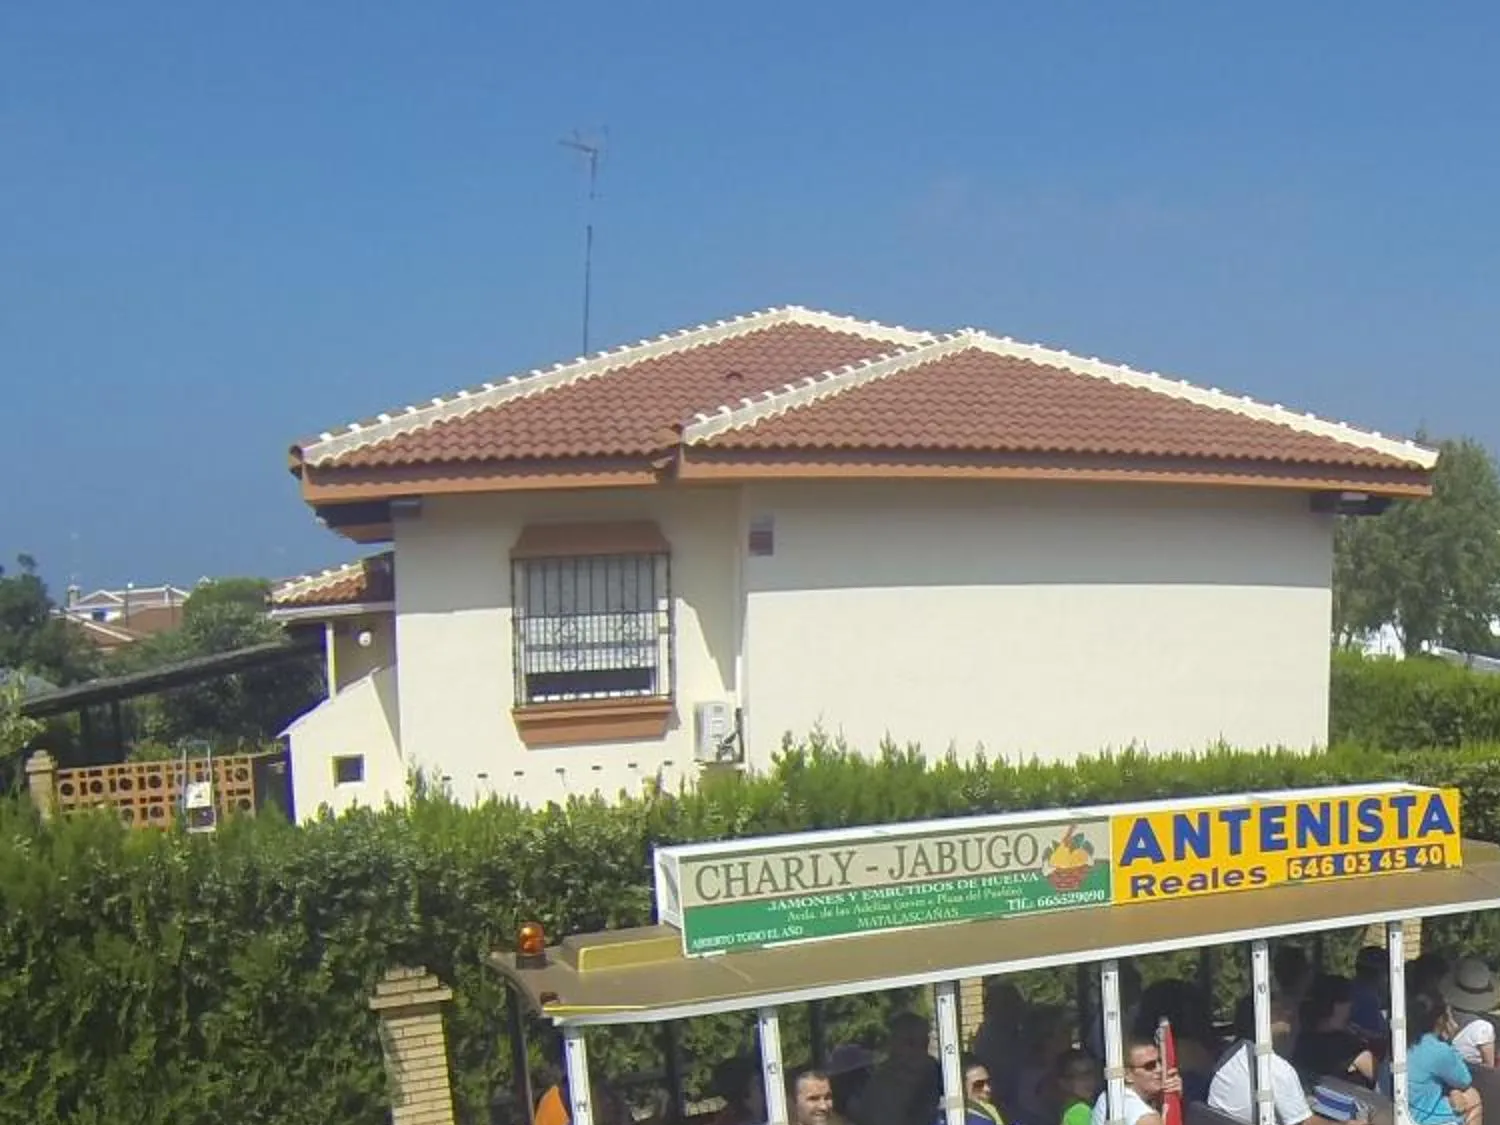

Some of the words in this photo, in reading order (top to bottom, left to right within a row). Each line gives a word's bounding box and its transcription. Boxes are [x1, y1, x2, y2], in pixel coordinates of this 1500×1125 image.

[1119, 793, 1454, 867] ANTENISTA
[695, 850, 857, 901] CHARLY
[888, 833, 1039, 881] JABUGO
[1130, 865, 1268, 898] Reales
[1289, 858, 1335, 880] 646
[1343, 853, 1372, 873] 03
[1379, 850, 1407, 870] 45
[1414, 847, 1444, 866] 40
[768, 893, 845, 911] JAMONES
[863, 880, 955, 900] EMBUTIDOS
[957, 877, 978, 890] DE
[981, 872, 1039, 887] HUELVA
[857, 907, 959, 928] MATALASCAÑAS
